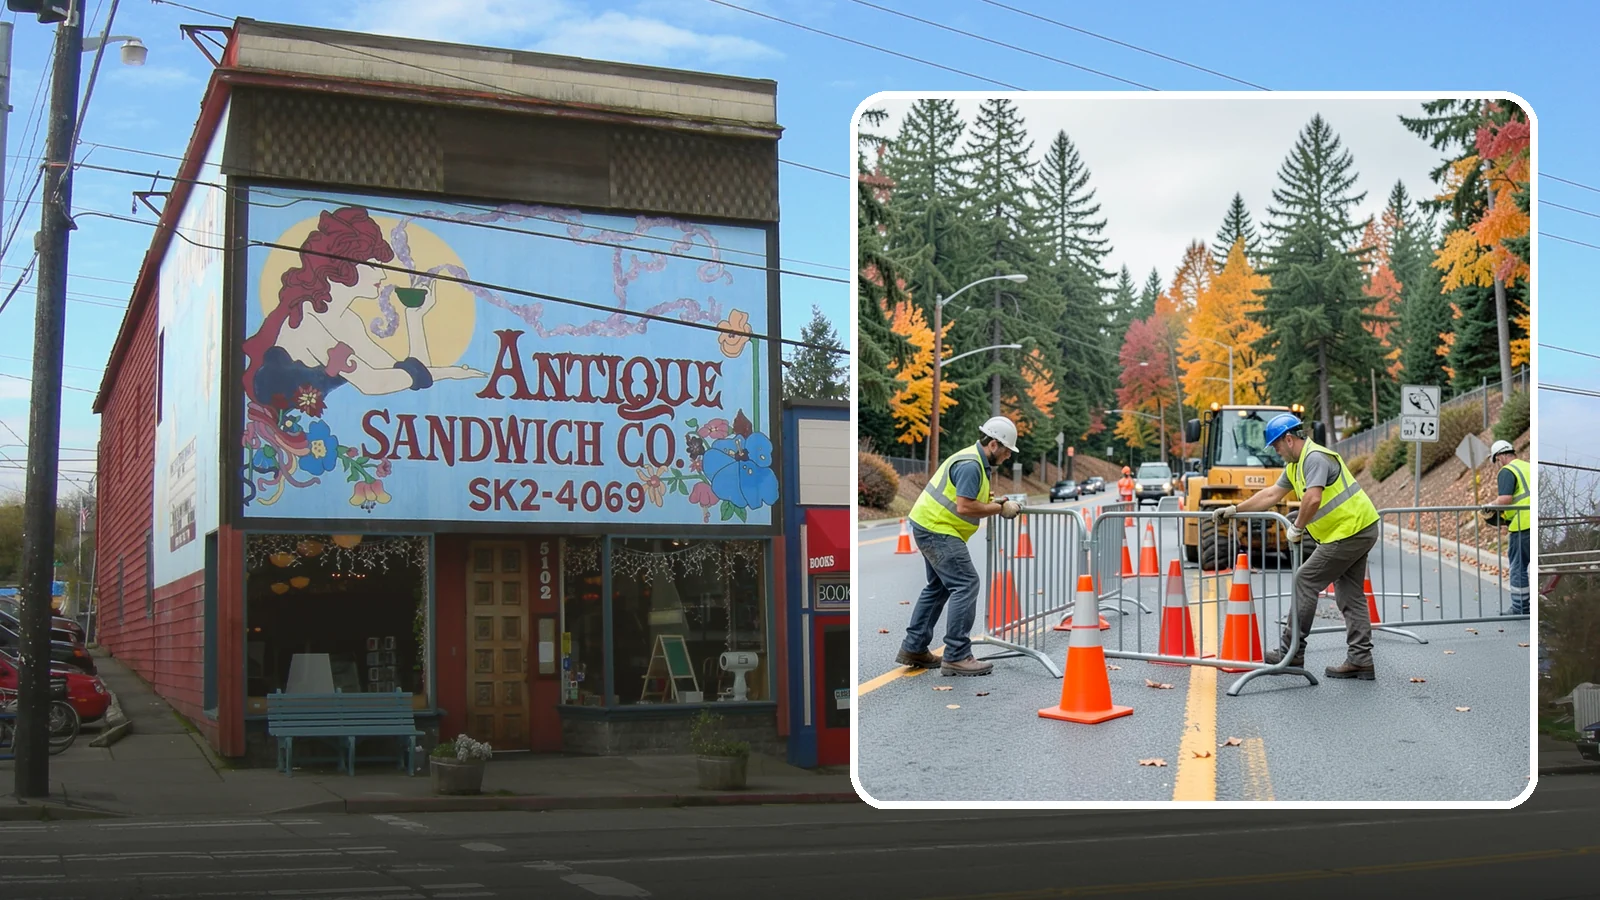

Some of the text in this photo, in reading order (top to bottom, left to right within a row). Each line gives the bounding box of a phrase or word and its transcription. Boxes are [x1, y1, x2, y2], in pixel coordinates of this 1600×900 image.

[476, 329, 724, 421] ANTIQUE
[361, 409, 685, 469] SANDWICH CO.
[468, 477, 646, 513] SK2-4069
[540, 541, 551, 600] 5102
[809, 555, 835, 568] BOOKS
